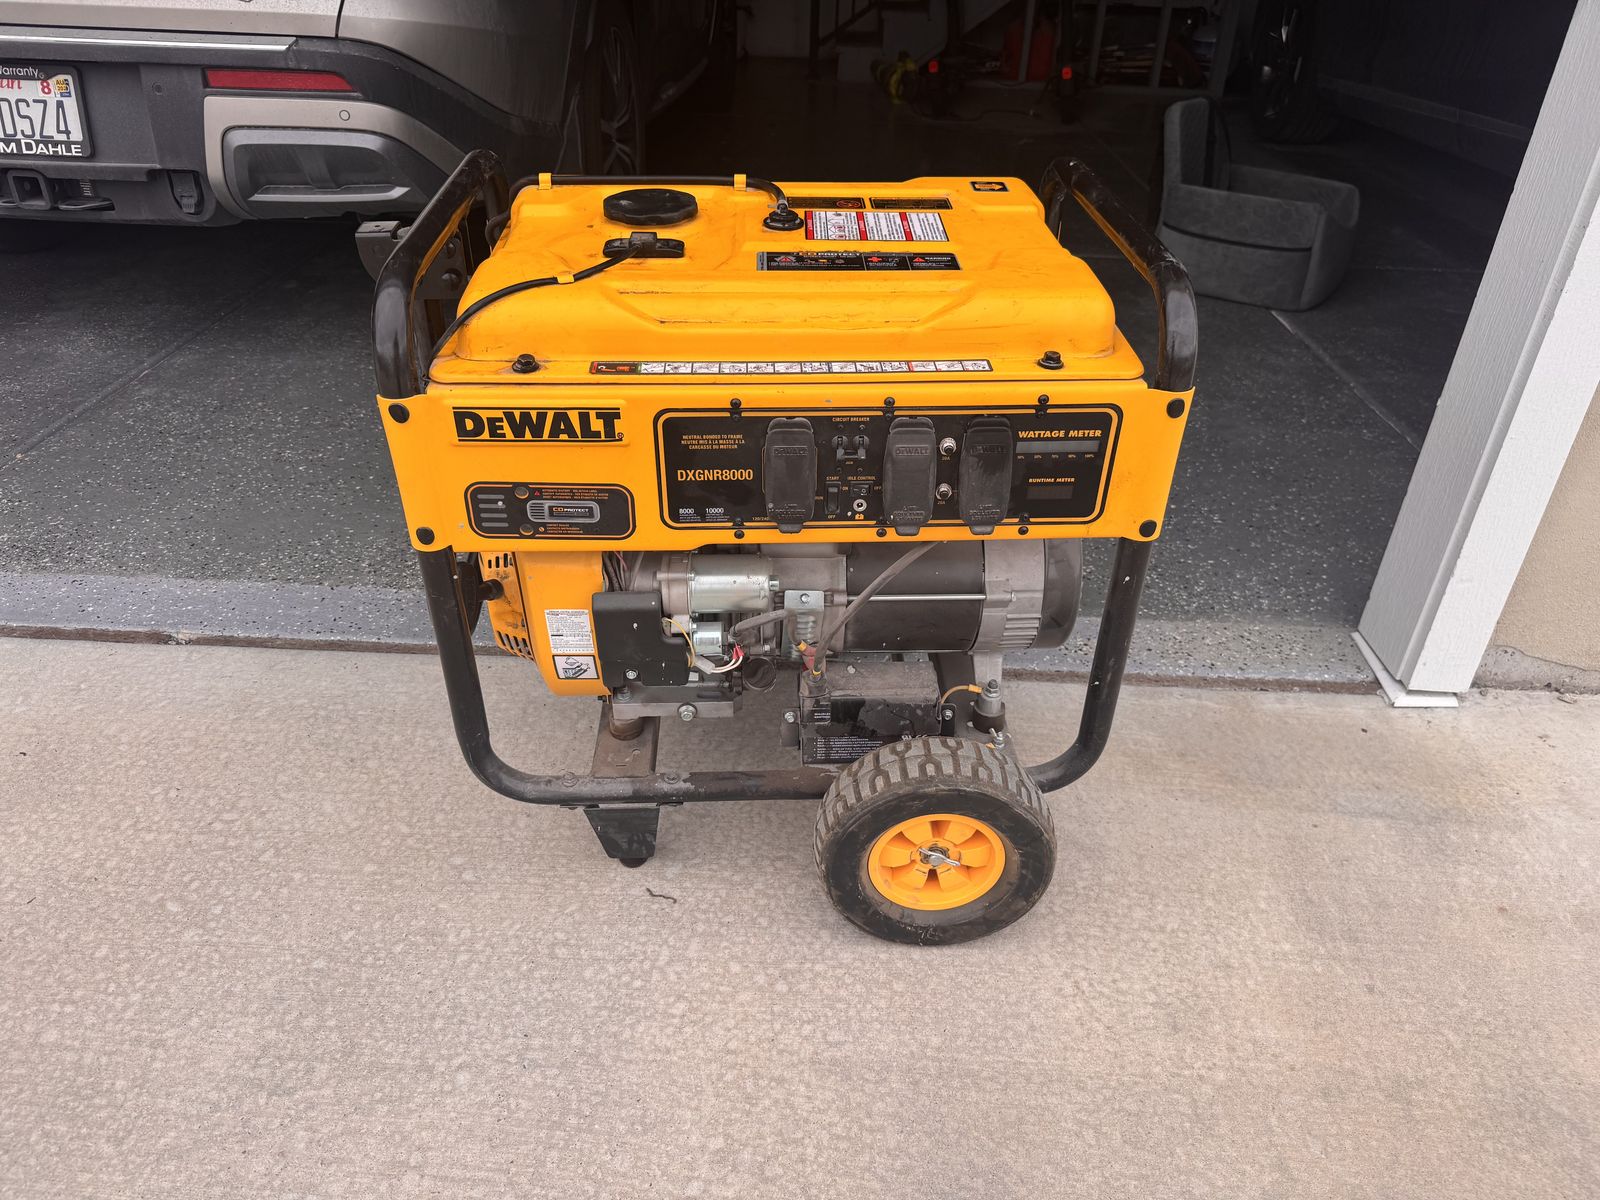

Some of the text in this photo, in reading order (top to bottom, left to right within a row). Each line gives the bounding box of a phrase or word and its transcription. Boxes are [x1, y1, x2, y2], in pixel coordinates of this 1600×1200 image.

[0, 65, 39, 78] arranty
[40, 79, 52, 95] 8
[21, 139, 82, 156] DAHLE
[453, 410, 622, 439] DEWALT
[1018, 429, 1102, 438] WATTAGE METER
[677, 469, 753, 481] DXGNR8000
